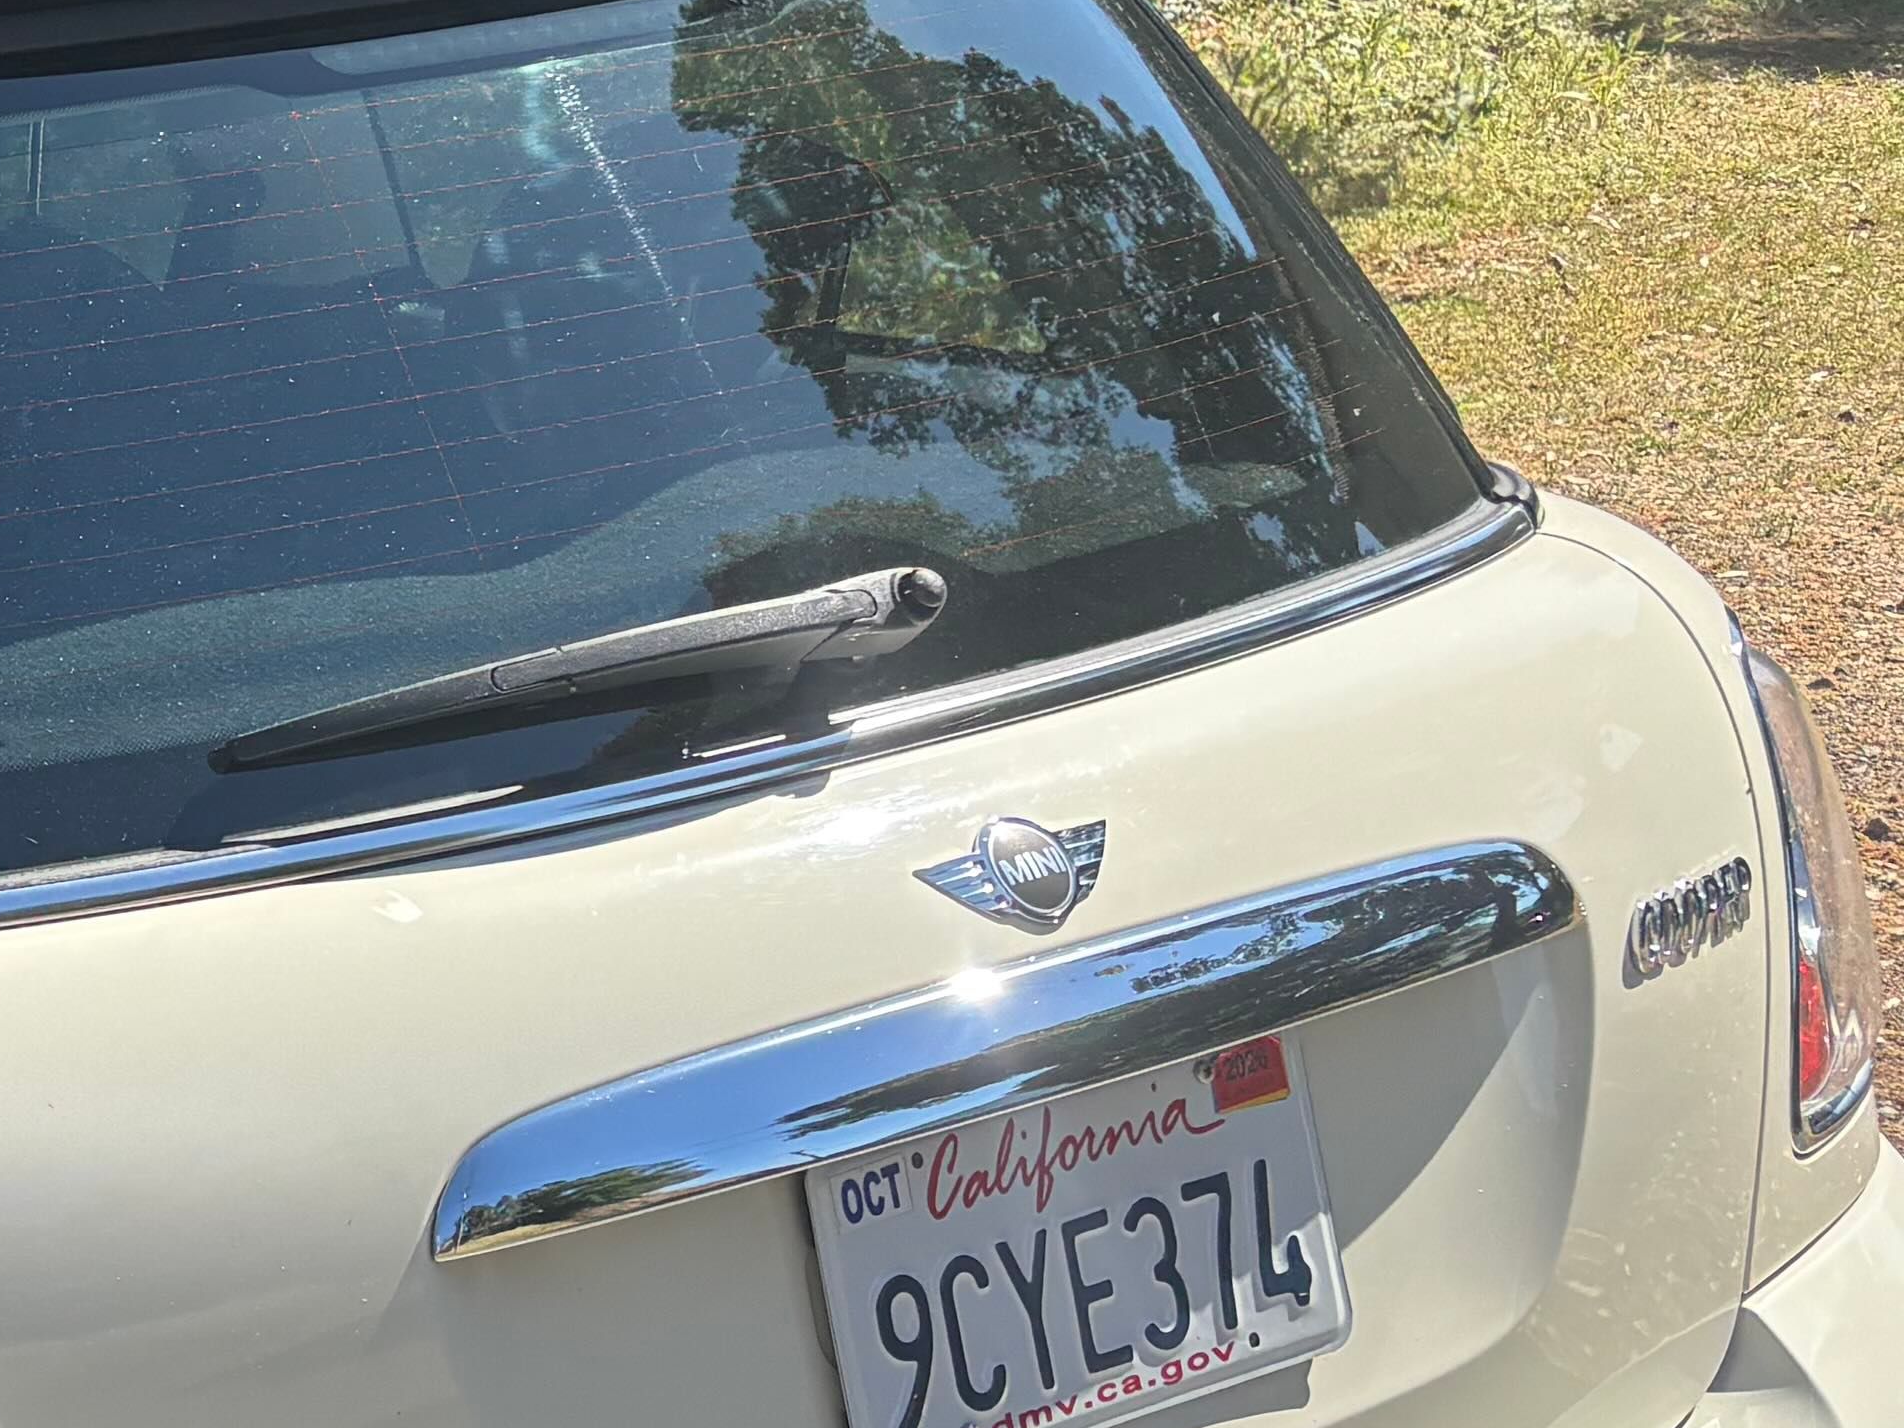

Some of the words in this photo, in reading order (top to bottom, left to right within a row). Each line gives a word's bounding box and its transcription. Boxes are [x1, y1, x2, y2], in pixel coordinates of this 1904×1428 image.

[998, 845, 1067, 885] MINI
[926, 1098, 1225, 1220] California
[840, 1162, 901, 1224] OCT
